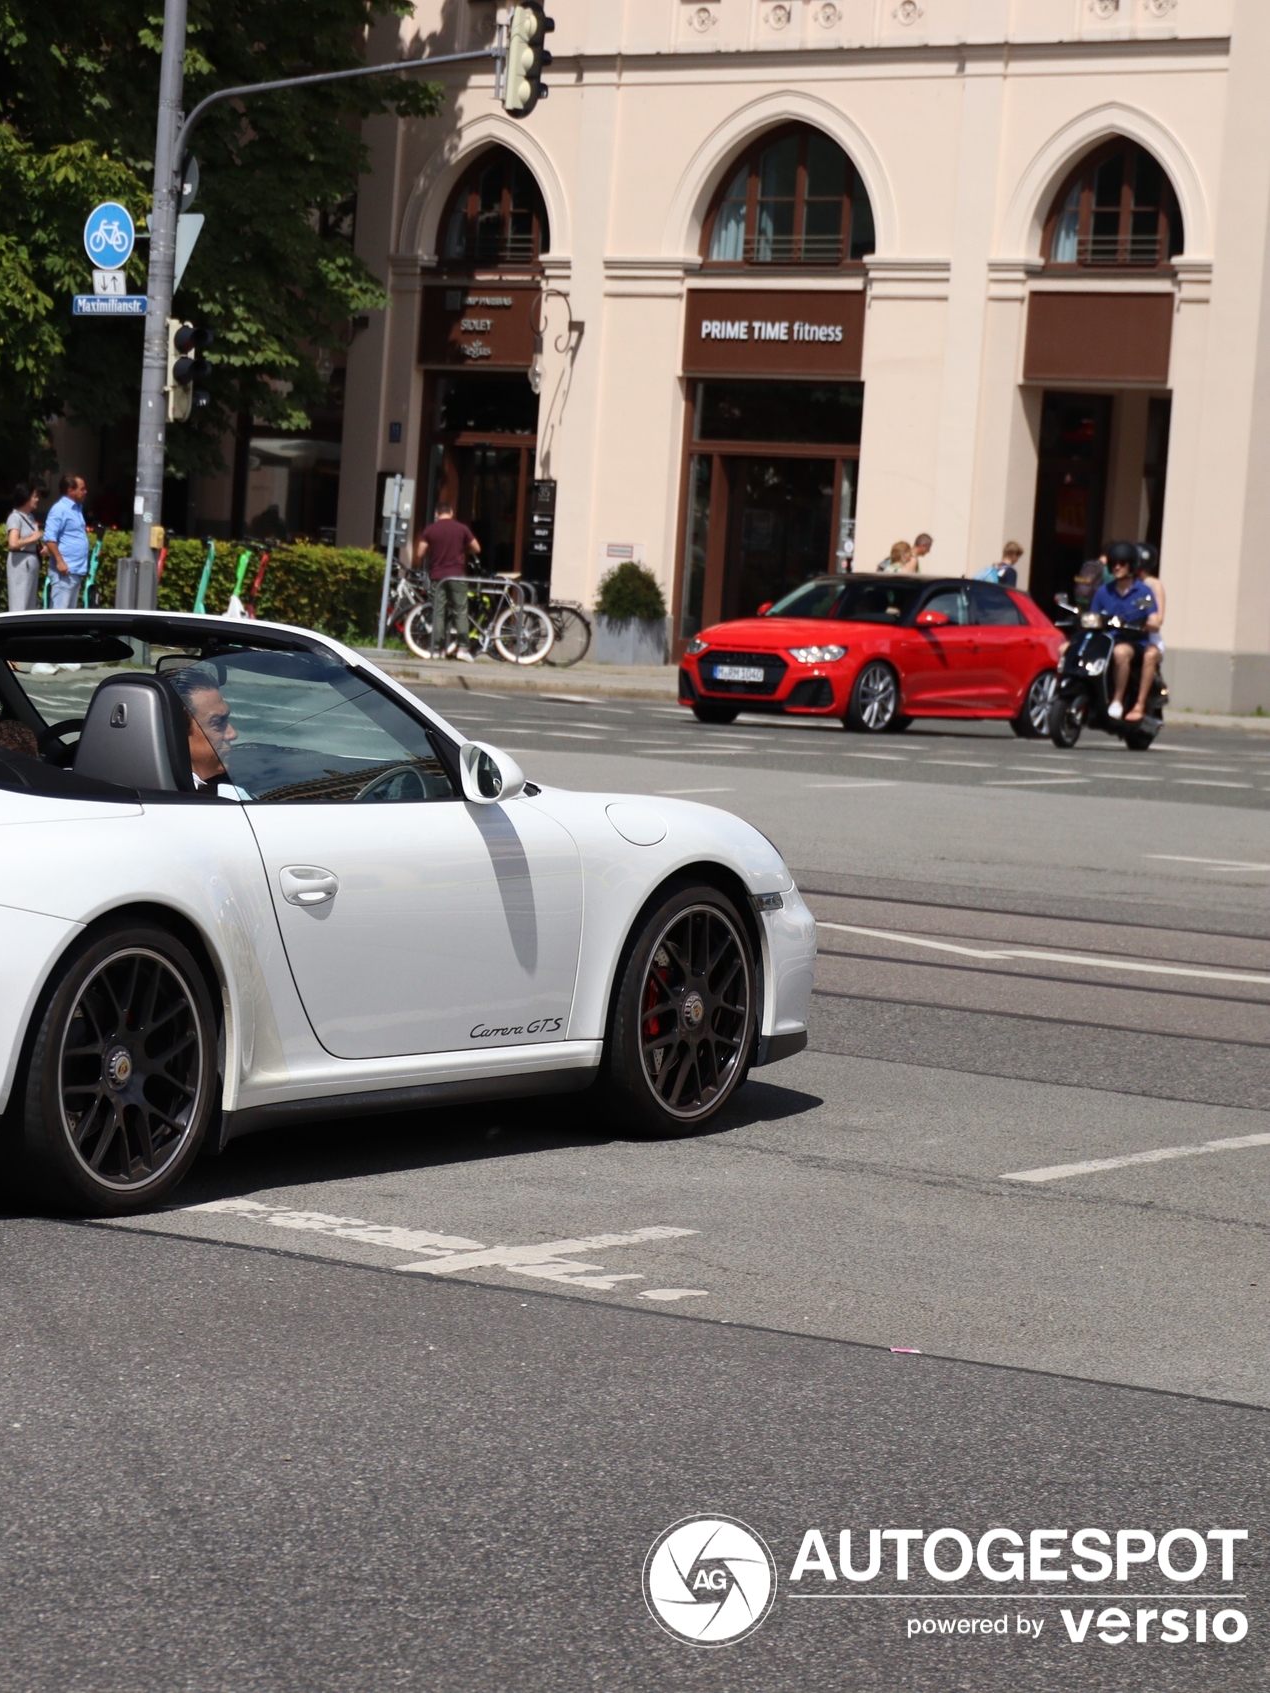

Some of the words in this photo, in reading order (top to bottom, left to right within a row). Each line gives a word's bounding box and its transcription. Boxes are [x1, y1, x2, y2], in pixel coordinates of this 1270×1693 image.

[77, 298, 143, 313] Maximilianstr.
[461, 319, 492, 331] SIDLEY
[701, 320, 749, 340] PRIME
[752, 321, 789, 340] TIME
[793, 321, 843, 341] fitness
[470, 1023, 523, 1039] Carrera
[526, 1017, 563, 1034] GTS
